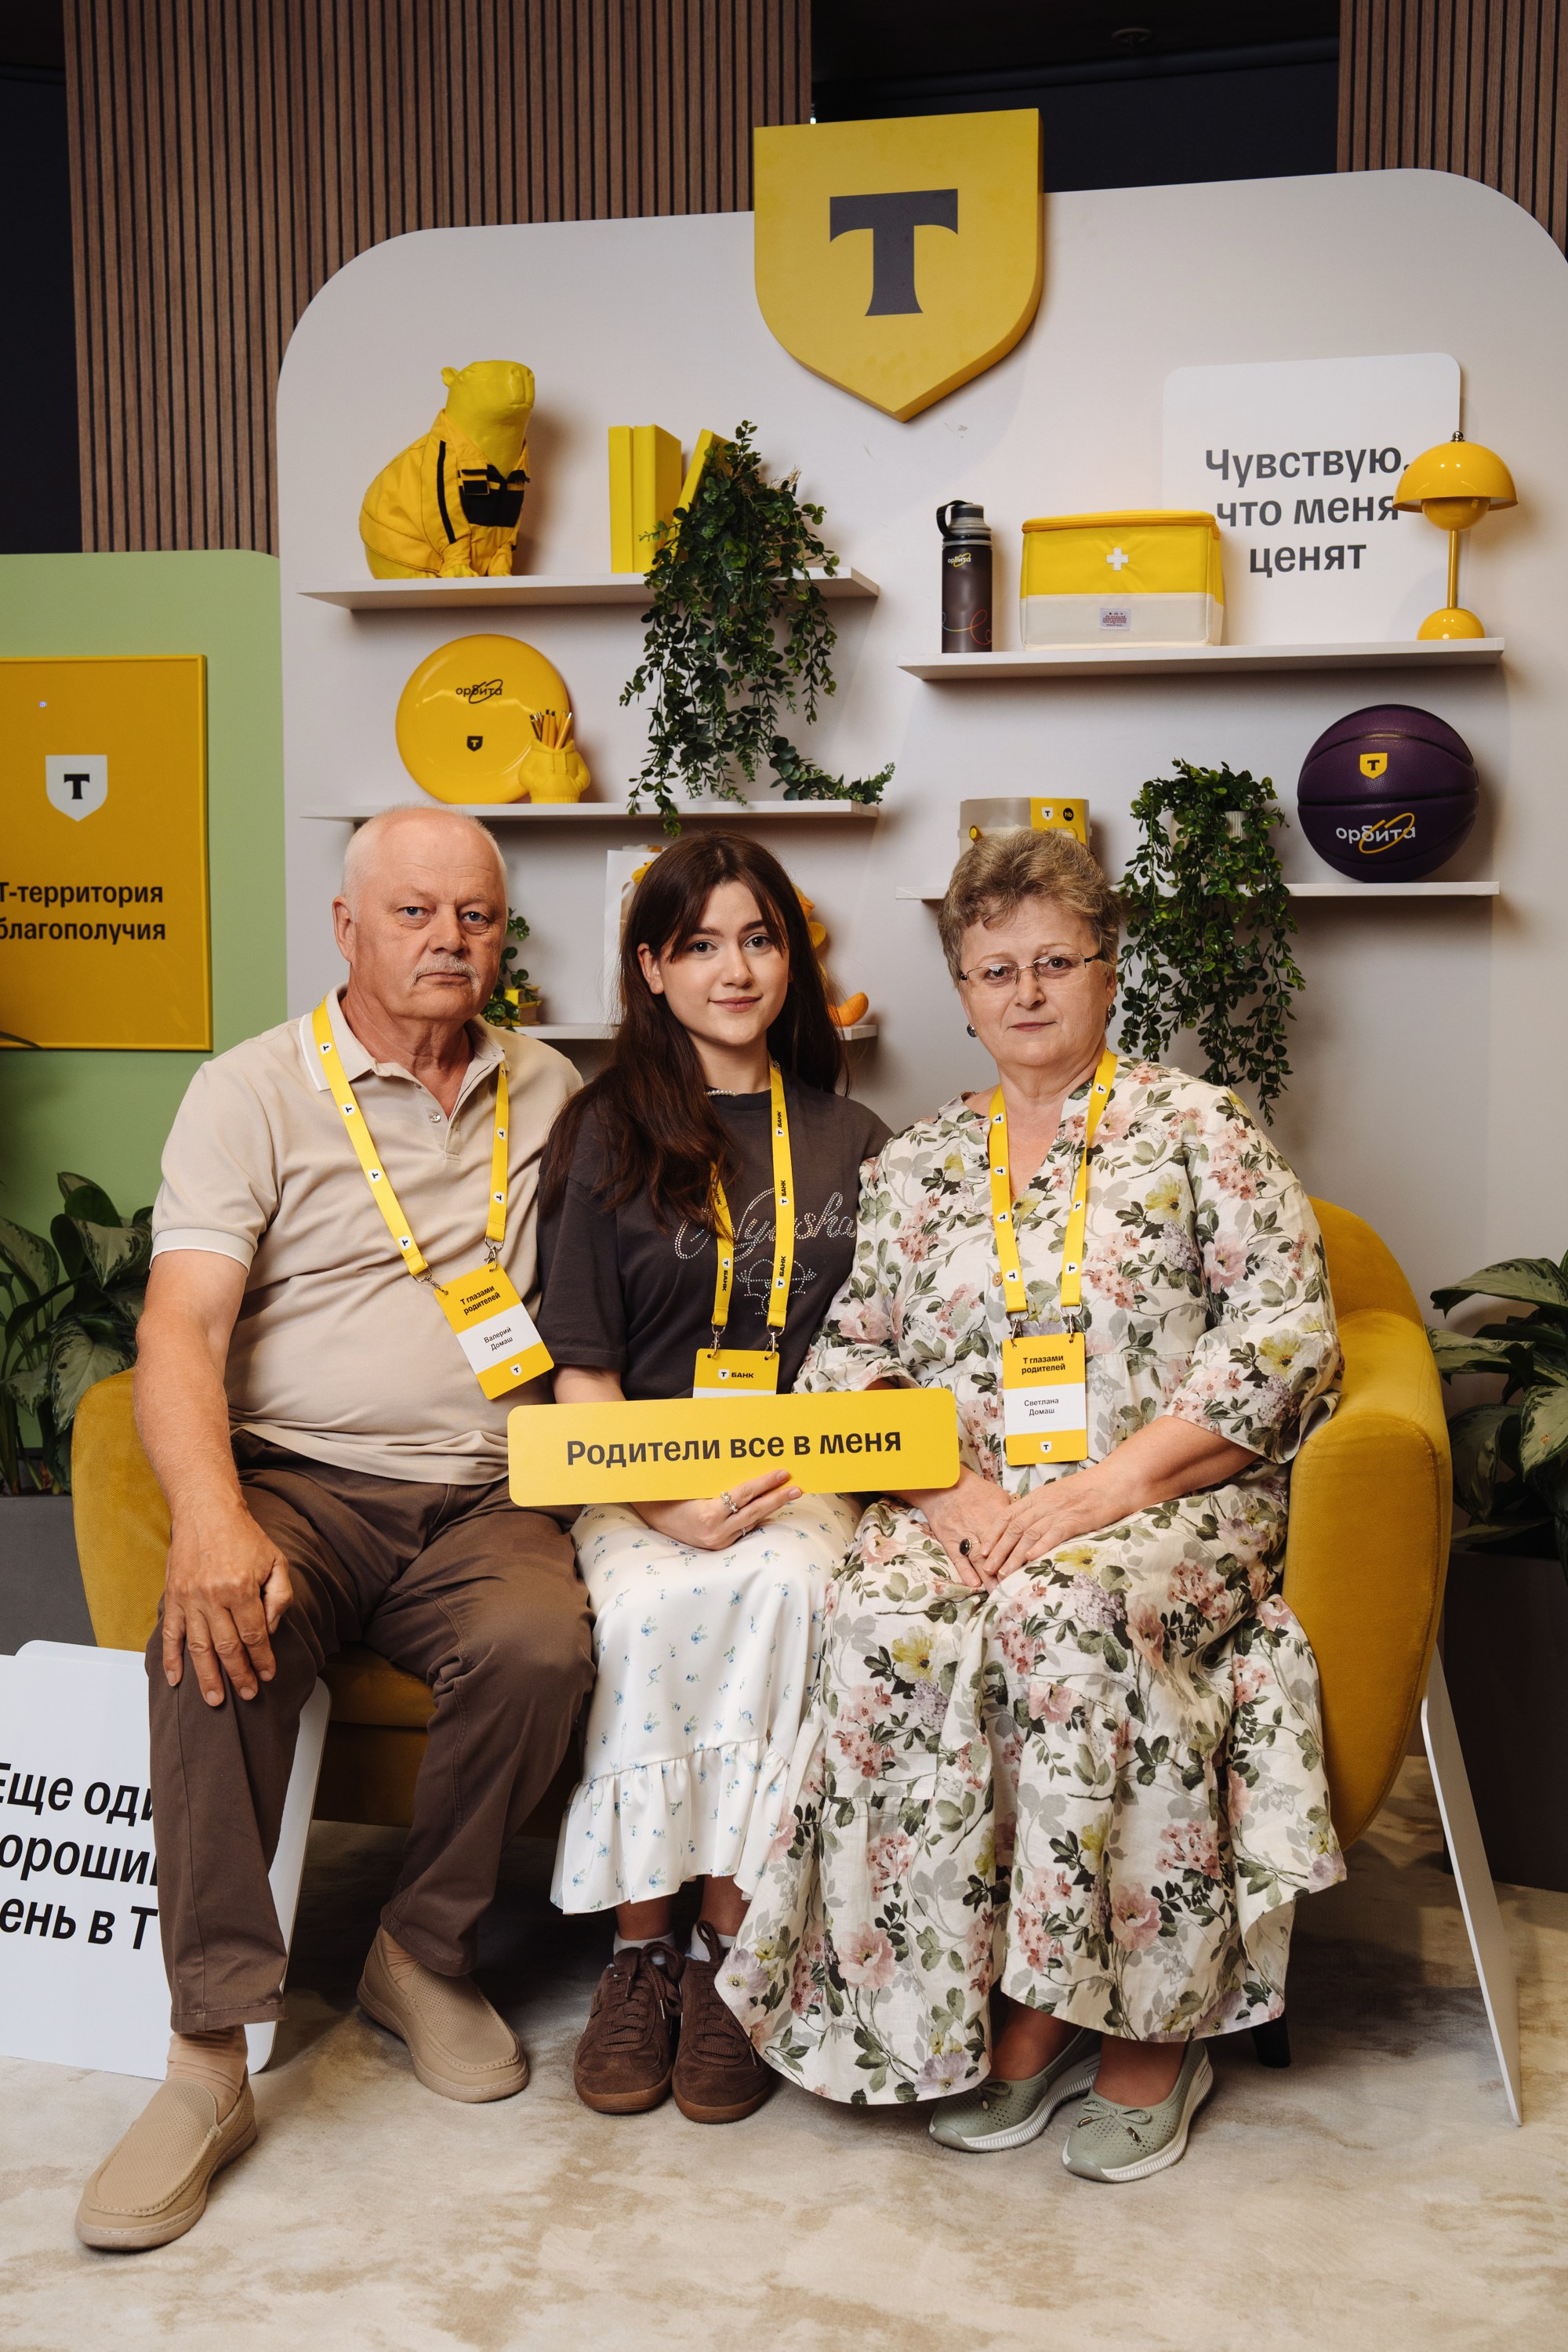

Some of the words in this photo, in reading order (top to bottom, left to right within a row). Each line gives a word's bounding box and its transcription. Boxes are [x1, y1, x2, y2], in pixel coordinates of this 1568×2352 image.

[829, 188, 959, 318] Т
[1217, 499, 1282, 527] что
[1293, 495, 1399, 524] меня
[1250, 544, 1367, 579] ценят
[455, 684, 503, 699] орбита
[63, 773, 90, 800] Т
[1334, 823, 1417, 846] орбита
[0, 880, 163, 909] Т-территория
[463, 1291, 501, 1316] родителей
[466, 1285, 495, 1303] глазами
[483, 1326, 512, 1344] Валерий
[490, 1336, 514, 1352] Домаш
[1022, 1363, 1066, 1375] родителей
[1029, 1355, 1064, 1364] глазами
[1024, 1398, 1059, 1406] Светлана
[1029, 1408, 1055, 1417] Домаш
[566, 1438, 720, 1469] Родители
[730, 1435, 785, 1459] все
[793, 1434, 811, 1456] в
[819, 1430, 902, 1455] меня
[0, 1834, 158, 1887] ороши
[87, 1909, 115, 1945] в
